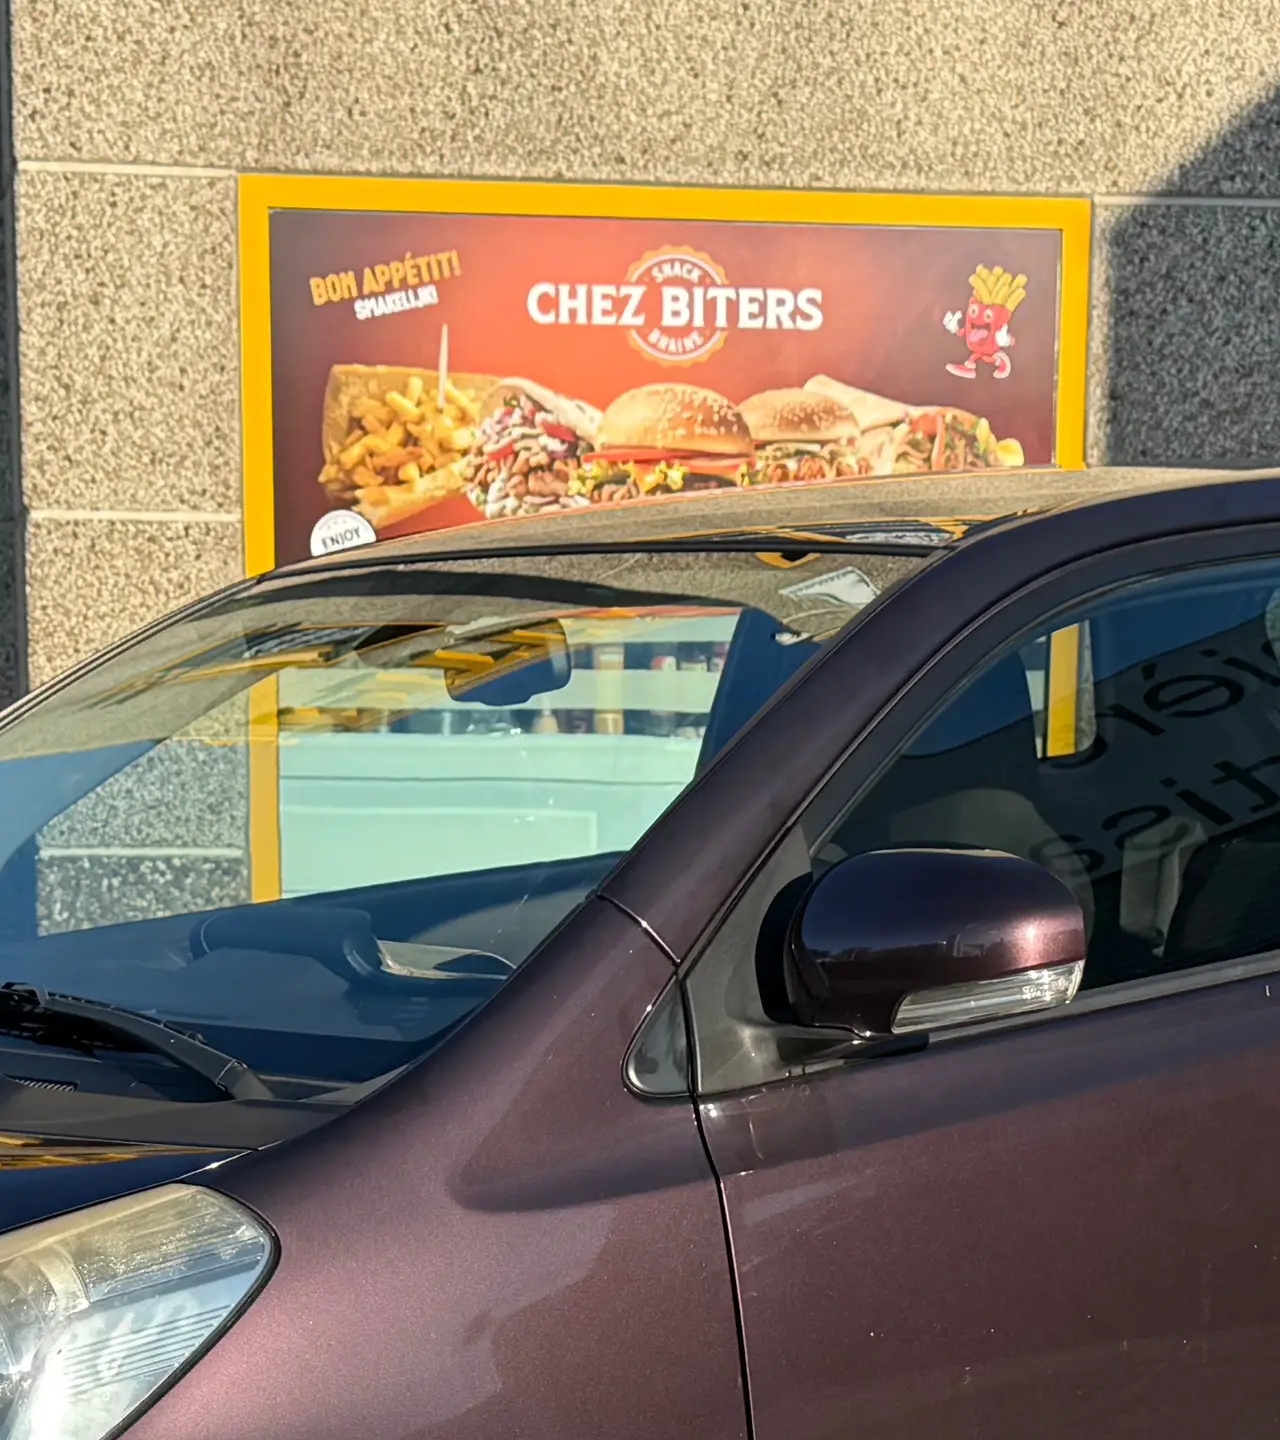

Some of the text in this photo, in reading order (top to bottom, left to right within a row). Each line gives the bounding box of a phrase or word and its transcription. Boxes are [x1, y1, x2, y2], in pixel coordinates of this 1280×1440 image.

[309, 249, 462, 306] BON APPÉTIT!
[651, 261, 704, 283] SNACK
[527, 282, 824, 331] CHEZ BITERS
[321, 526, 361, 550] ENJOY
